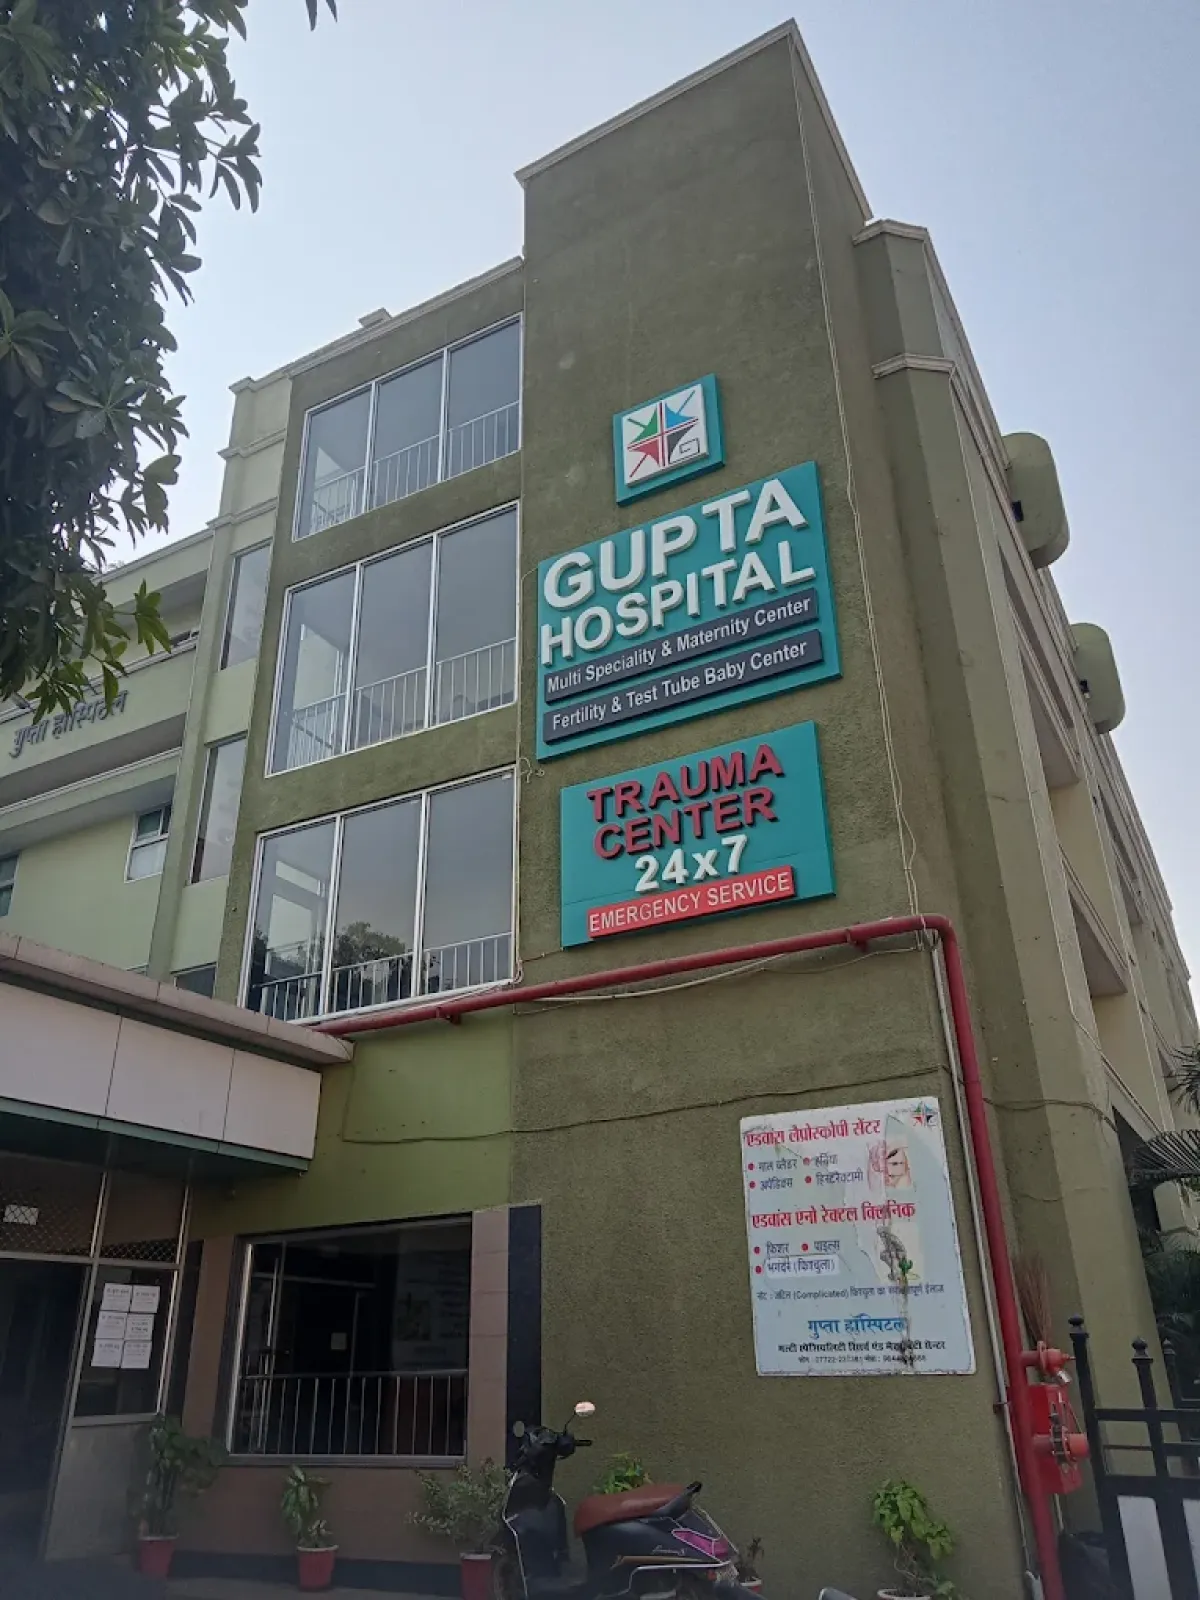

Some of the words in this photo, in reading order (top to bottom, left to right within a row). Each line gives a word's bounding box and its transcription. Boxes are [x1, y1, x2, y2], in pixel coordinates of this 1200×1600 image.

[543, 478, 808, 610] GUPTA
[540, 540, 816, 667] HOSPITAL
[547, 669, 582, 693] Multi
[585, 646, 657, 683] Speciality
[661, 641, 673, 659] &
[677, 617, 750, 655] Maternity
[754, 597, 811, 628] Center
[552, 701, 607, 730] Fertility
[610, 696, 623, 714] &
[626, 687, 658, 709] Test
[661, 676, 701, 699] Tube
[704, 660, 747, 685] Baby
[750, 642, 808, 671] Center
[586, 744, 784, 823] TRAUMA
[593, 787, 779, 859] CENTER
[634, 834, 748, 892] 24x7
[588, 891, 702, 933] EMERGENCY
[706, 871, 790, 907] SERVICE
[853, 1117, 881, 1138] सेंटर
[752, 1208, 792, 1229] एडवांस
[807, 1318, 840, 1340] गुप्ता
